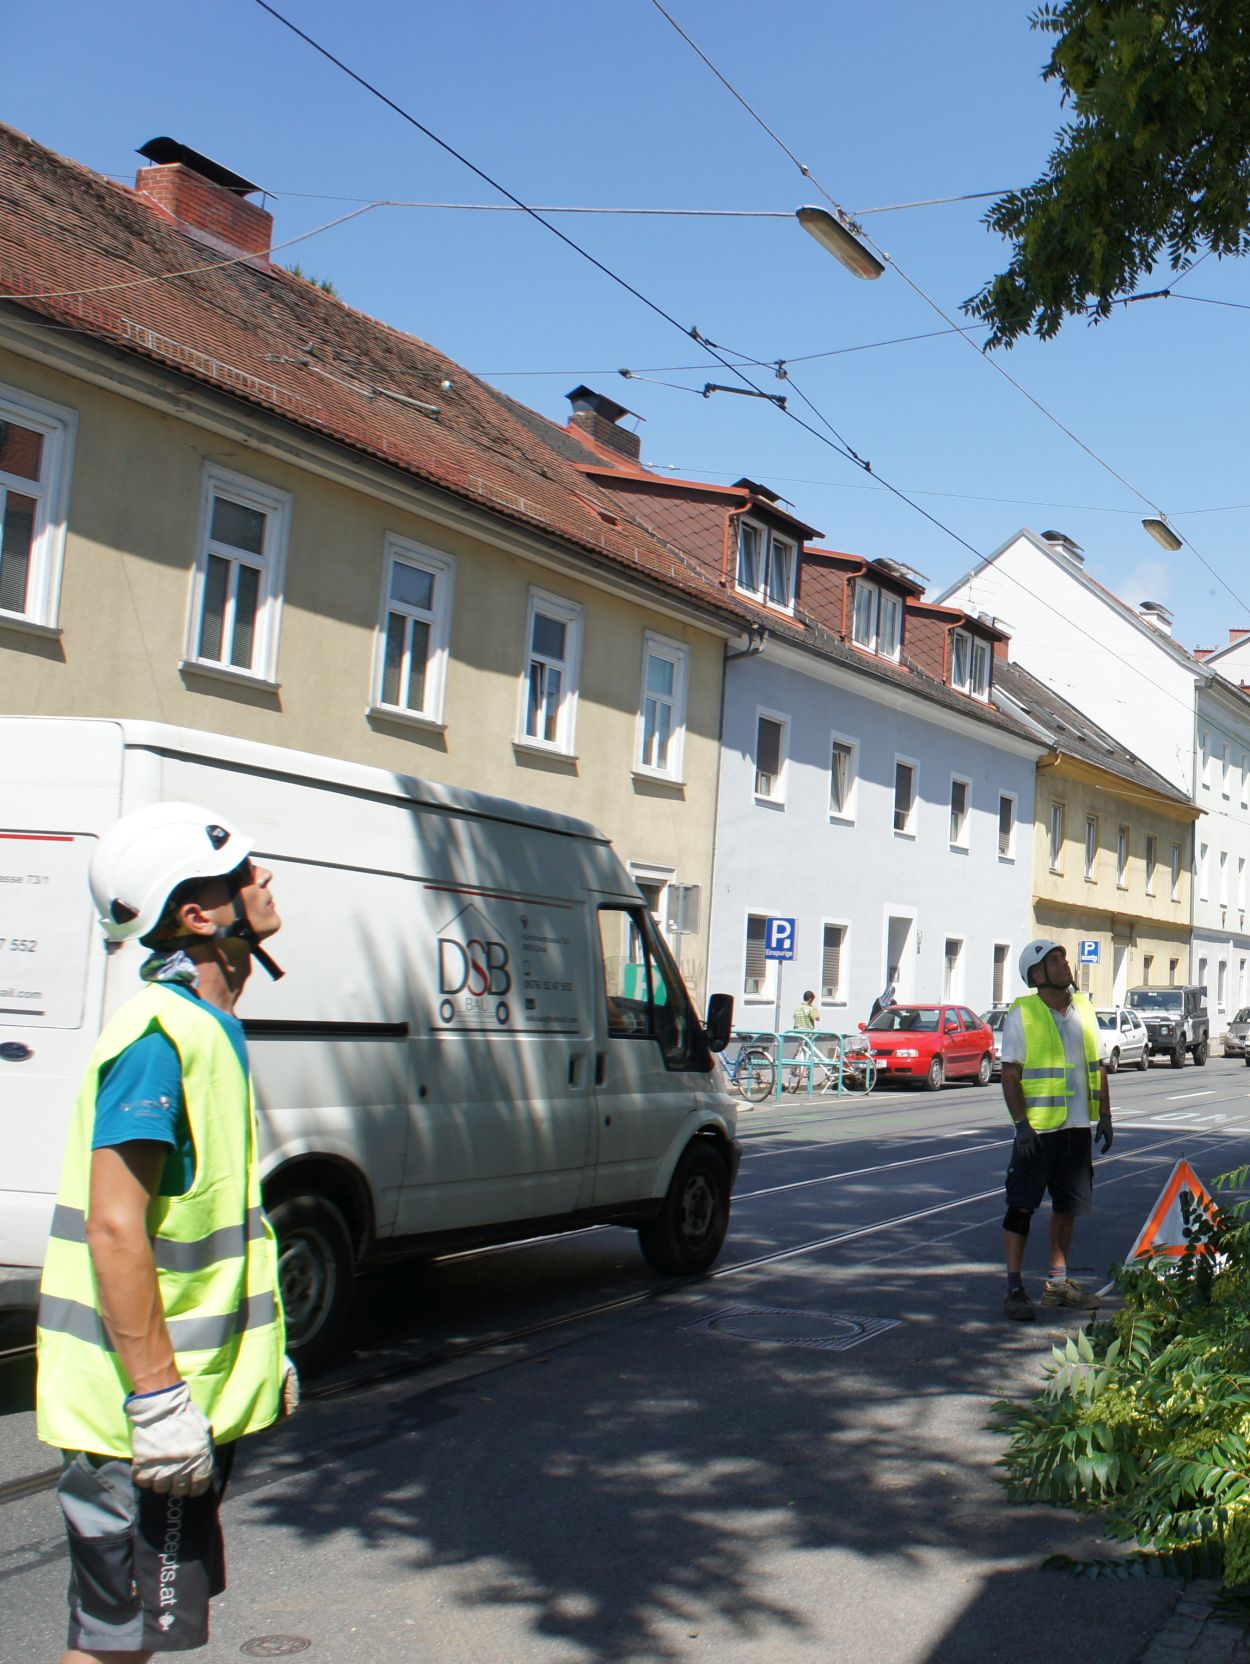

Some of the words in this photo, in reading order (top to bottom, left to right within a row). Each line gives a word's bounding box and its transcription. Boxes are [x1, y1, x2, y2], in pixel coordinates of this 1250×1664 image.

[10, 939, 38, 952] 552
[771, 919, 791, 948] P
[1084, 941, 1096, 956] P
[437, 938, 512, 996] DSB
[158, 1496, 183, 1608] concepts.at
